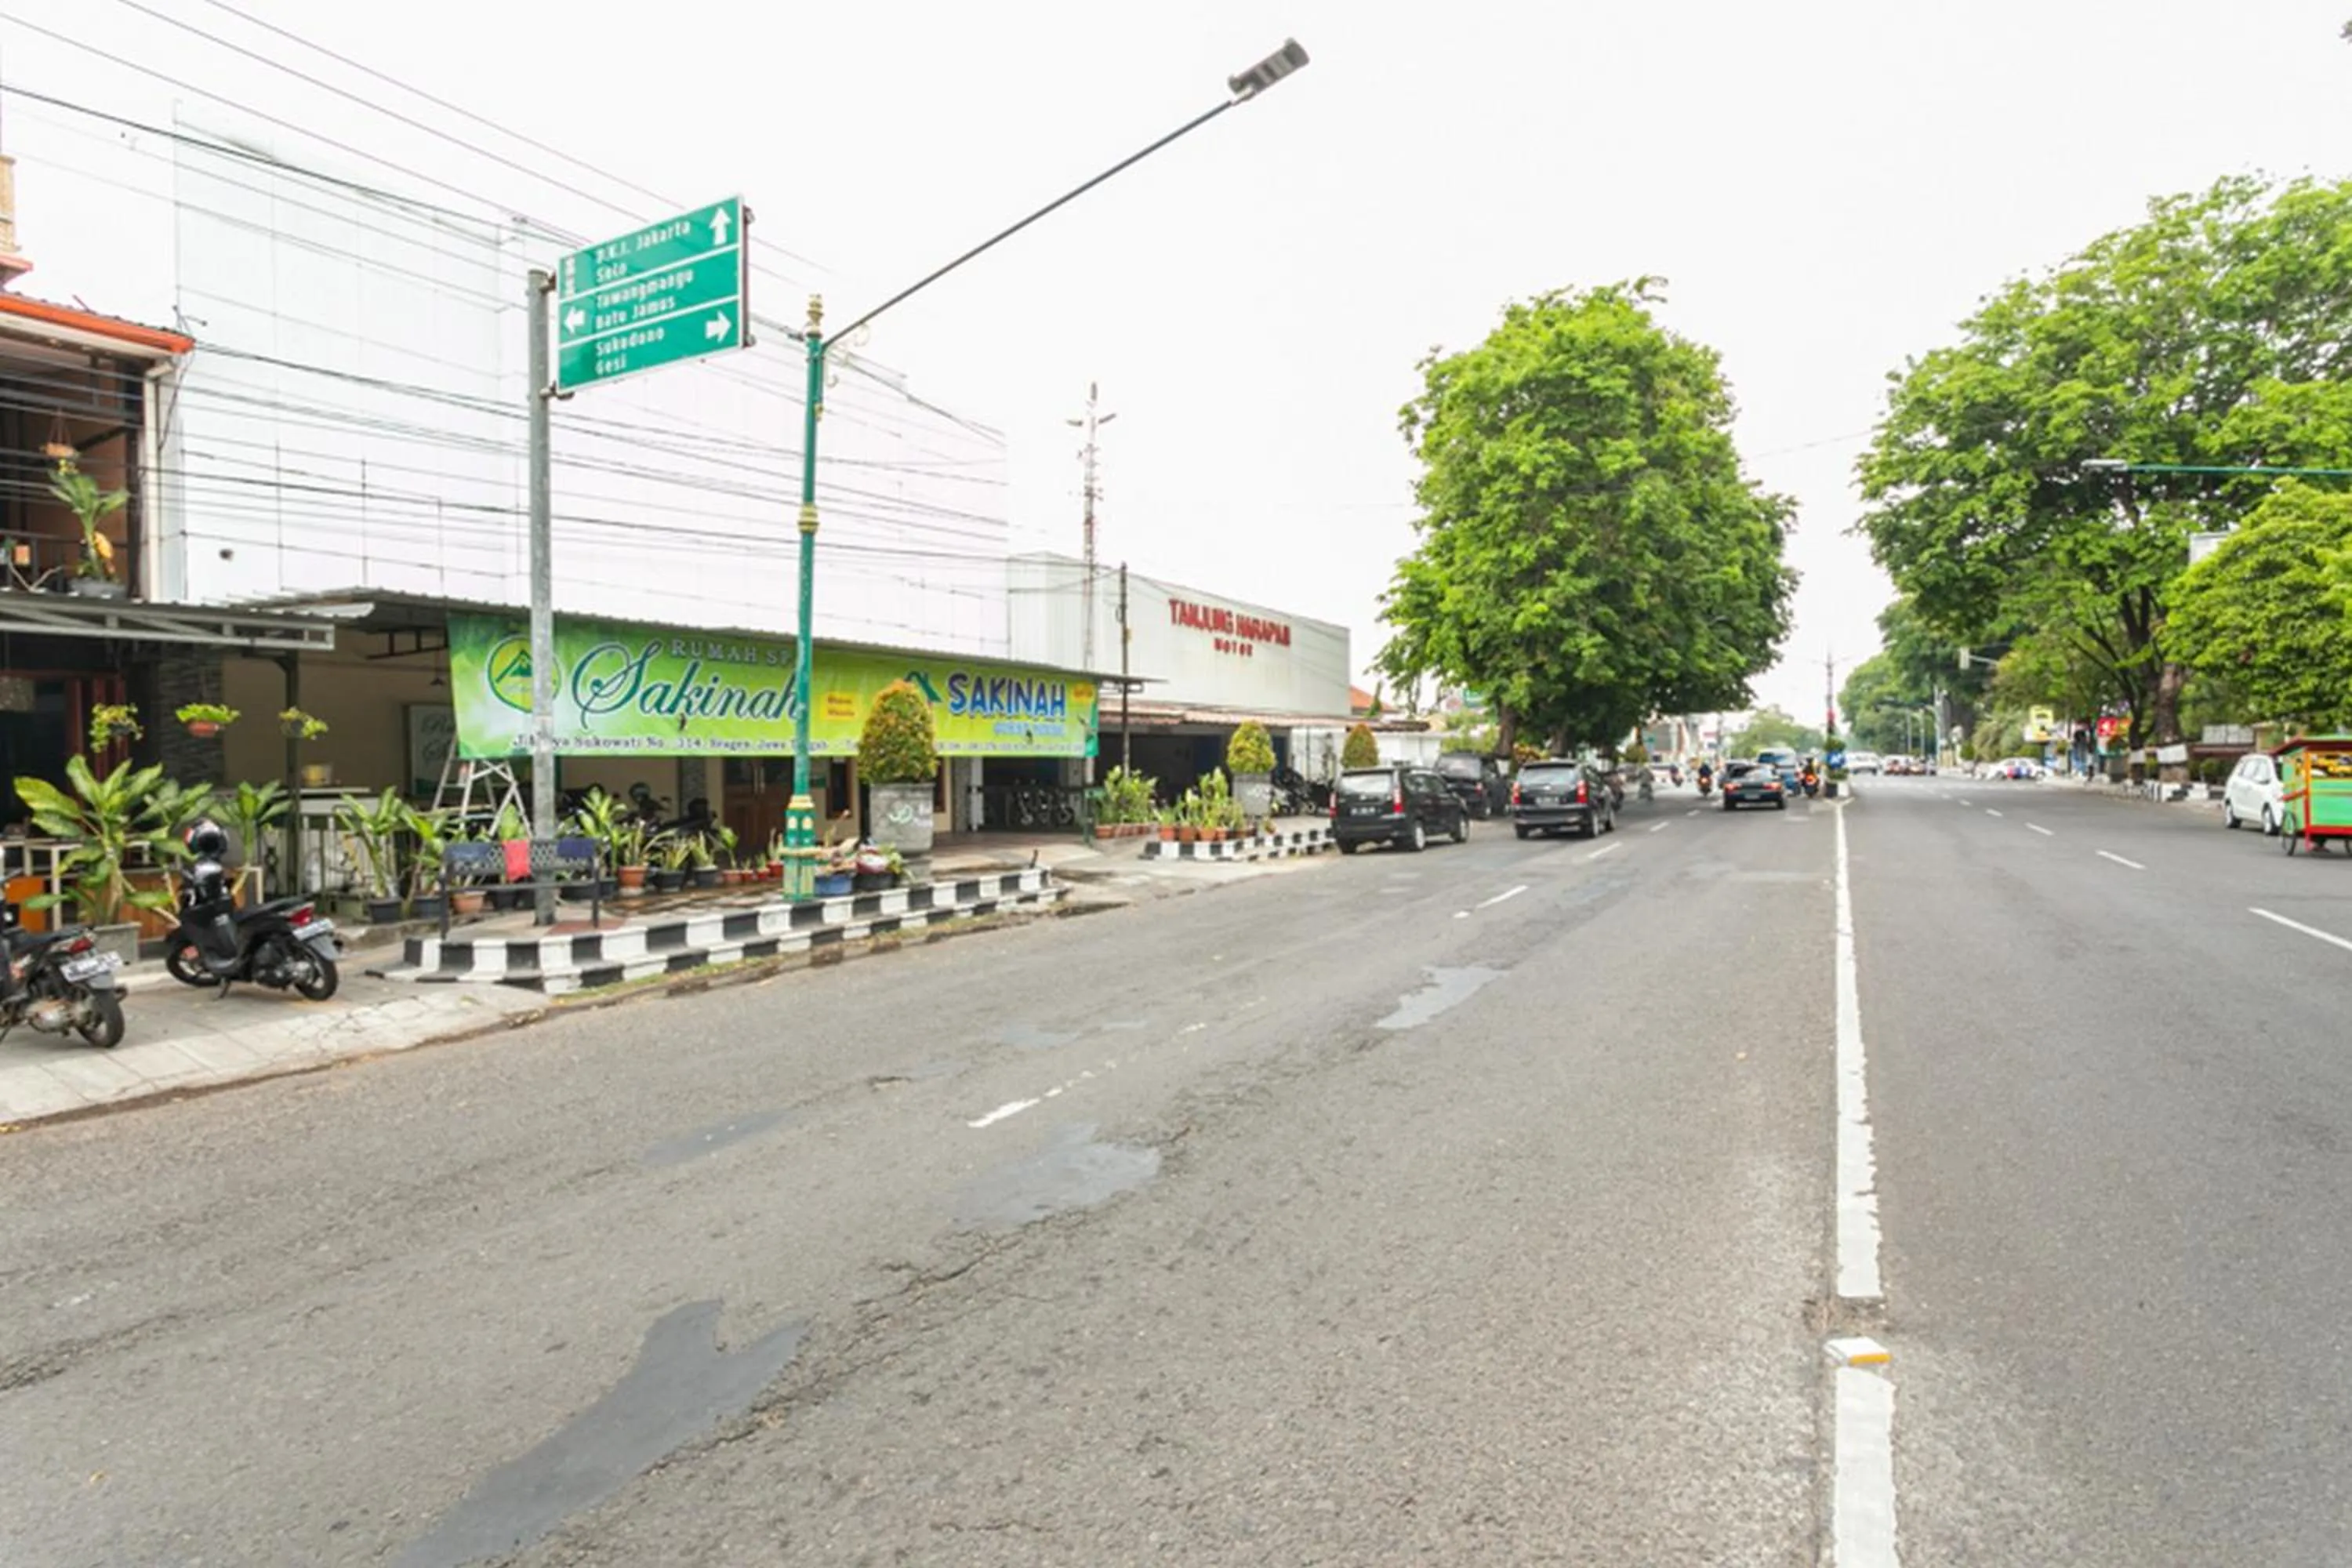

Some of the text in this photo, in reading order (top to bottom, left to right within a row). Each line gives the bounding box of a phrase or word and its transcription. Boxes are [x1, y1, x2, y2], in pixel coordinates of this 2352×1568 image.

[637, 220, 691, 250] Jakarta
[596, 268, 694, 308] Tawangmangu
[632, 296, 675, 319] Jamus
[595, 353, 627, 376] Gesi
[1169, 597, 1234, 634] TANJUNG
[672, 638, 757, 664] RUMAH
[1214, 637, 1254, 657] MOTOR
[572, 640, 800, 729] Sakinah
[947, 672, 1066, 719] SAKINAH
